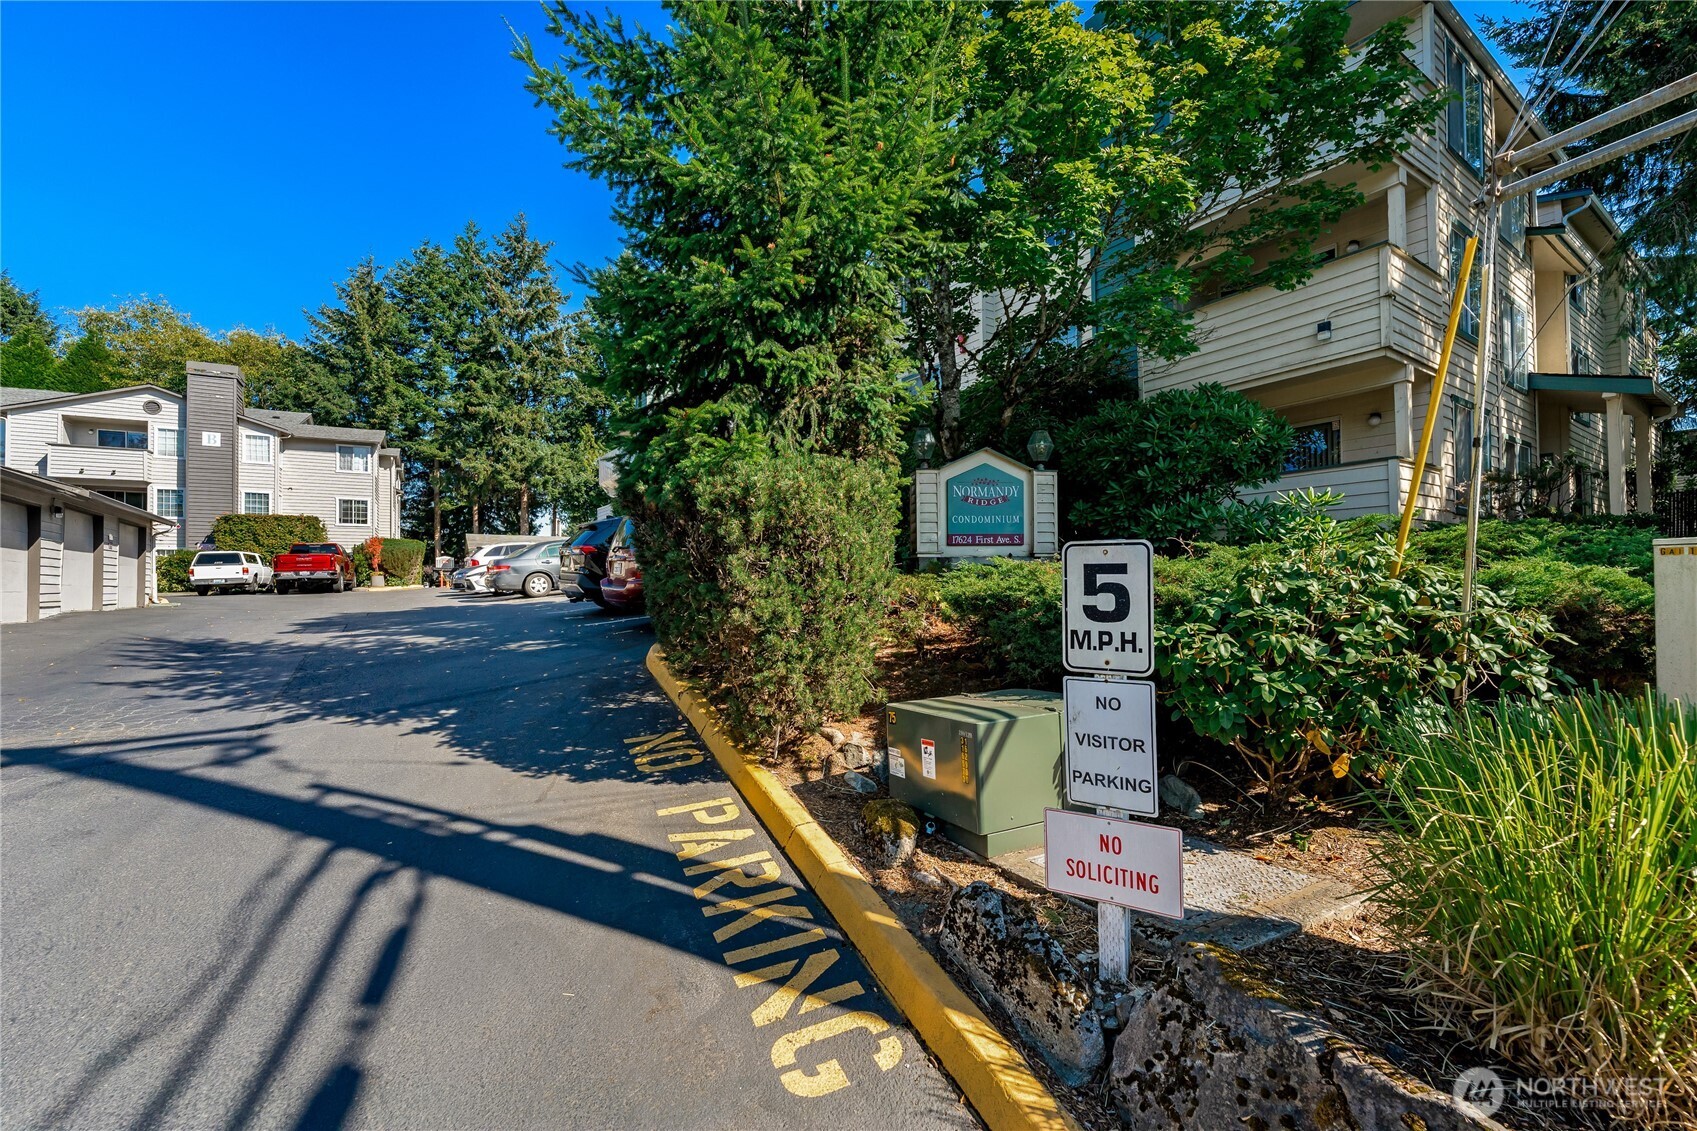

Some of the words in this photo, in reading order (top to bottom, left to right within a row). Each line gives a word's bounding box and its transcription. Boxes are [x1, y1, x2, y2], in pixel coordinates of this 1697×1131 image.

[207, 434, 217, 445] B
[953, 485, 1019, 497] NORMANDY
[968, 497, 1004, 505] RIDGE
[952, 515, 1019, 523] CONDOMINIUM
[952, 535, 972, 543] 17624
[976, 535, 993, 543] First
[996, 535, 1011, 543] Ave.
[1014, 535, 1021, 543] S.
[1082, 563, 1131, 623] 5
[1070, 629, 1143, 653] M.P.H.
[1095, 695, 1122, 711] NO
[888, 711, 896, 724] 75
[624, 730, 703, 774] NO
[1075, 732, 1146, 754] VISITOR
[1072, 769, 1152, 794] PARKING
[1100, 833, 1122, 855] NO
[1066, 857, 1160, 894] SOLICITING
[656, 796, 903, 1098] PARKING
